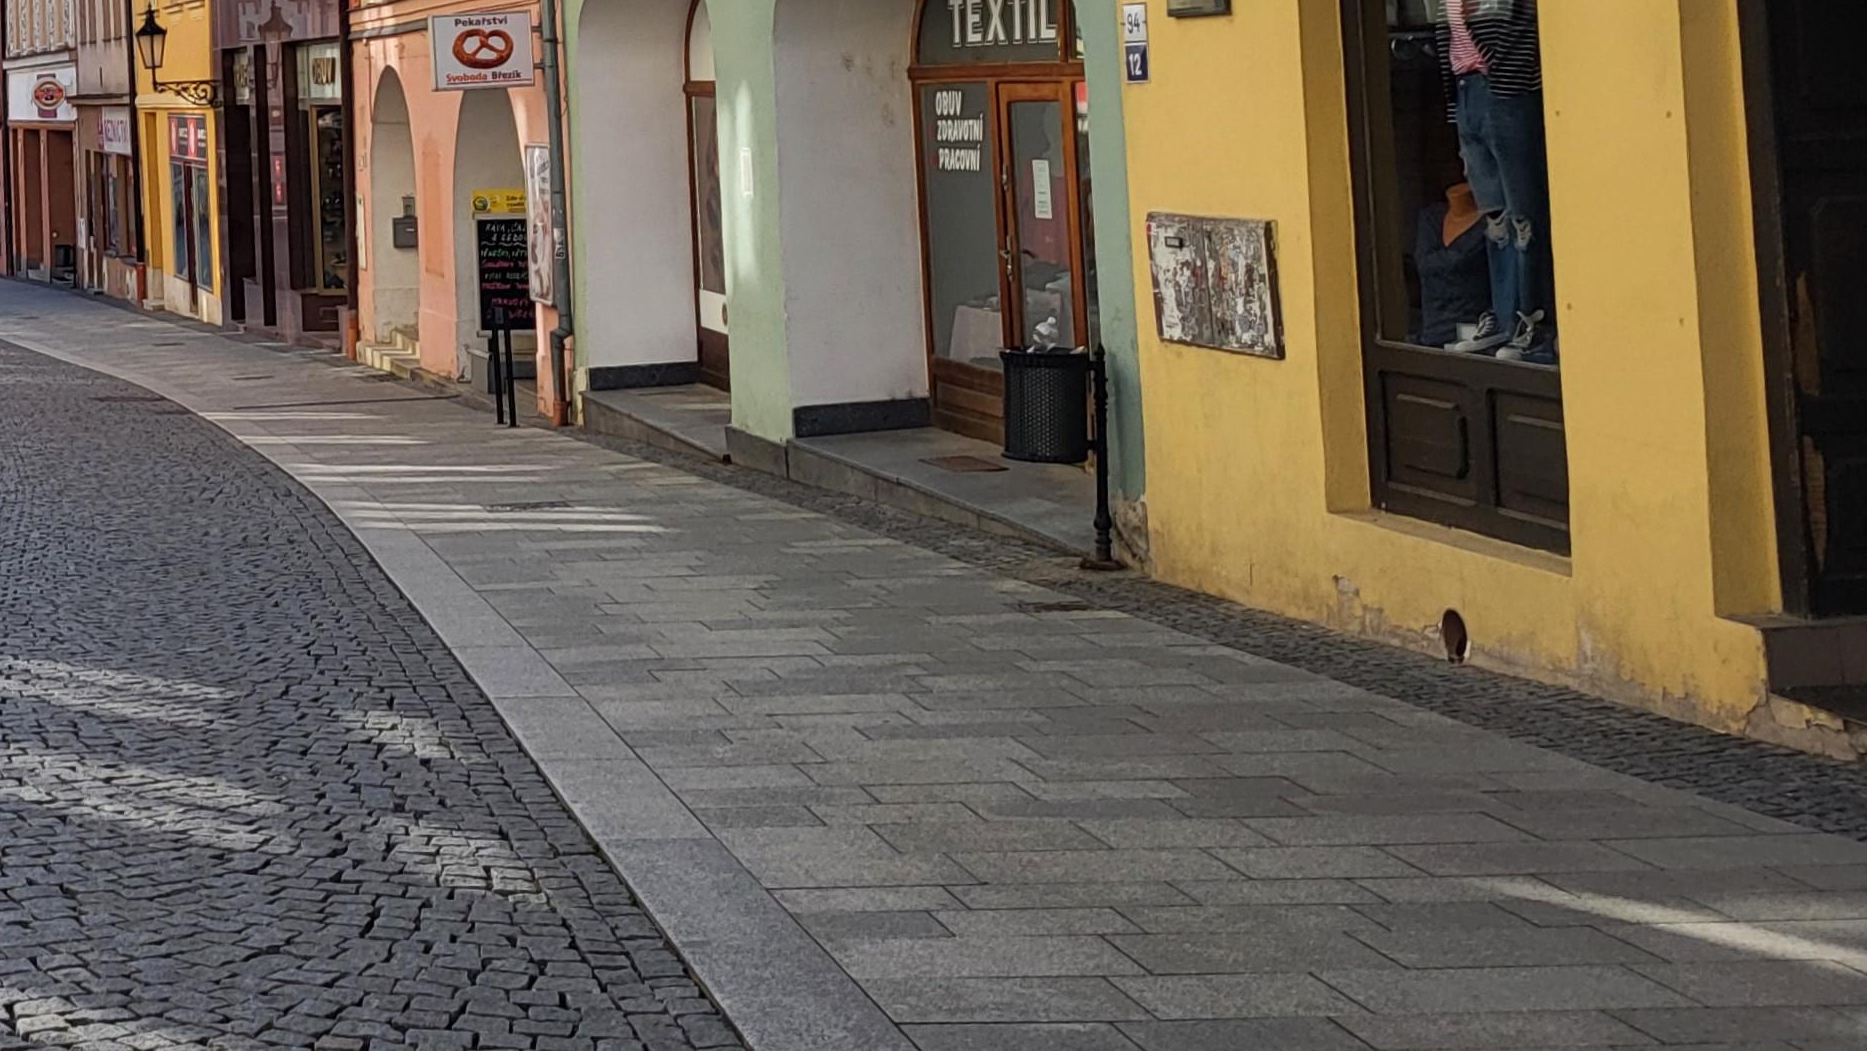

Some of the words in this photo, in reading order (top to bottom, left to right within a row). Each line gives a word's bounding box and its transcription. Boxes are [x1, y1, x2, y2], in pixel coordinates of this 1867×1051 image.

[1126, 12, 1141, 34] 94
[1129, 53, 1142, 76] 12
[446, 73, 488, 82] Svoboda
[935, 90, 962, 116] OBUV
[937, 113, 983, 142] ZDRAVOTNÍ
[938, 143, 981, 171] PRACOVNÍ
